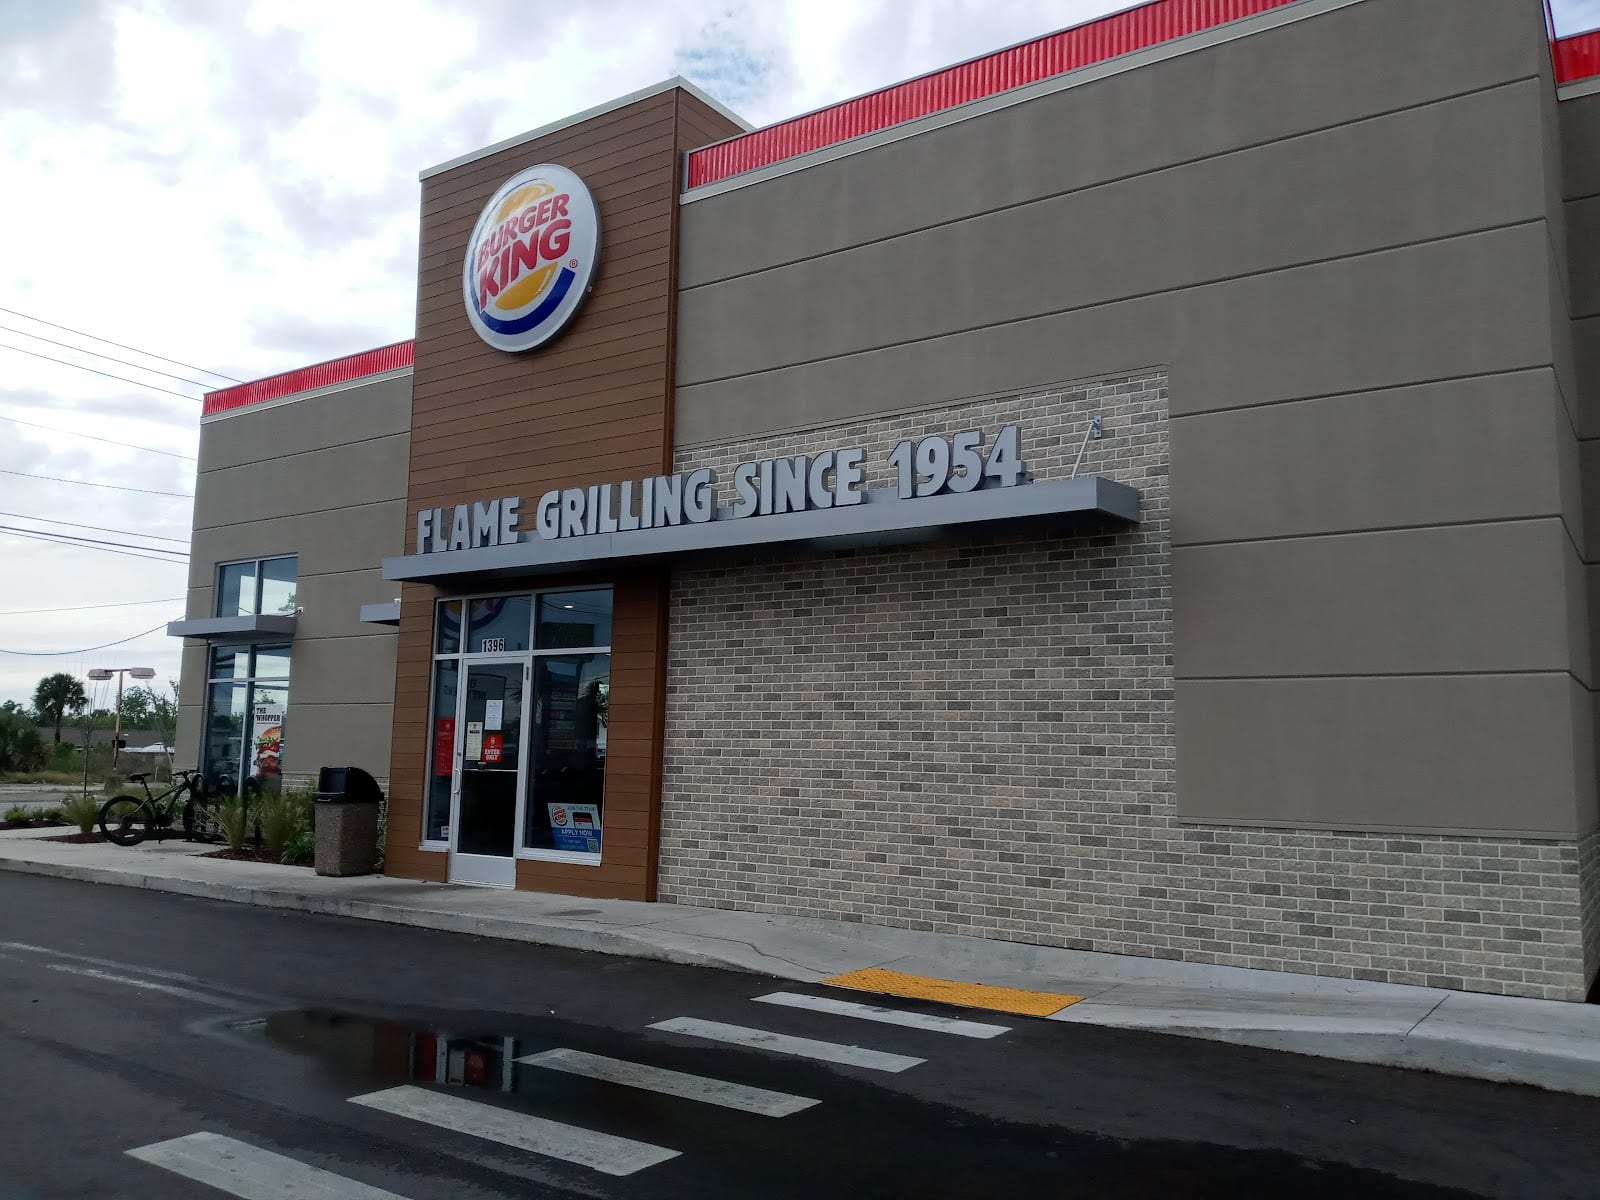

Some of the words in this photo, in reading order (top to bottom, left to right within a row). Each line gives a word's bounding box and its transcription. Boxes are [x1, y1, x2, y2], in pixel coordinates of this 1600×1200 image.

[477, 193, 569, 272] BURGER
[479, 218, 571, 313] KING
[416, 496, 520, 554] FLAME
[536, 468, 713, 540] GRILLING
[733, 448, 864, 518] SINCE
[887, 425, 1024, 499] 1954
[482, 638, 504, 652] 1396
[255, 714, 281, 722] WHOPPER
